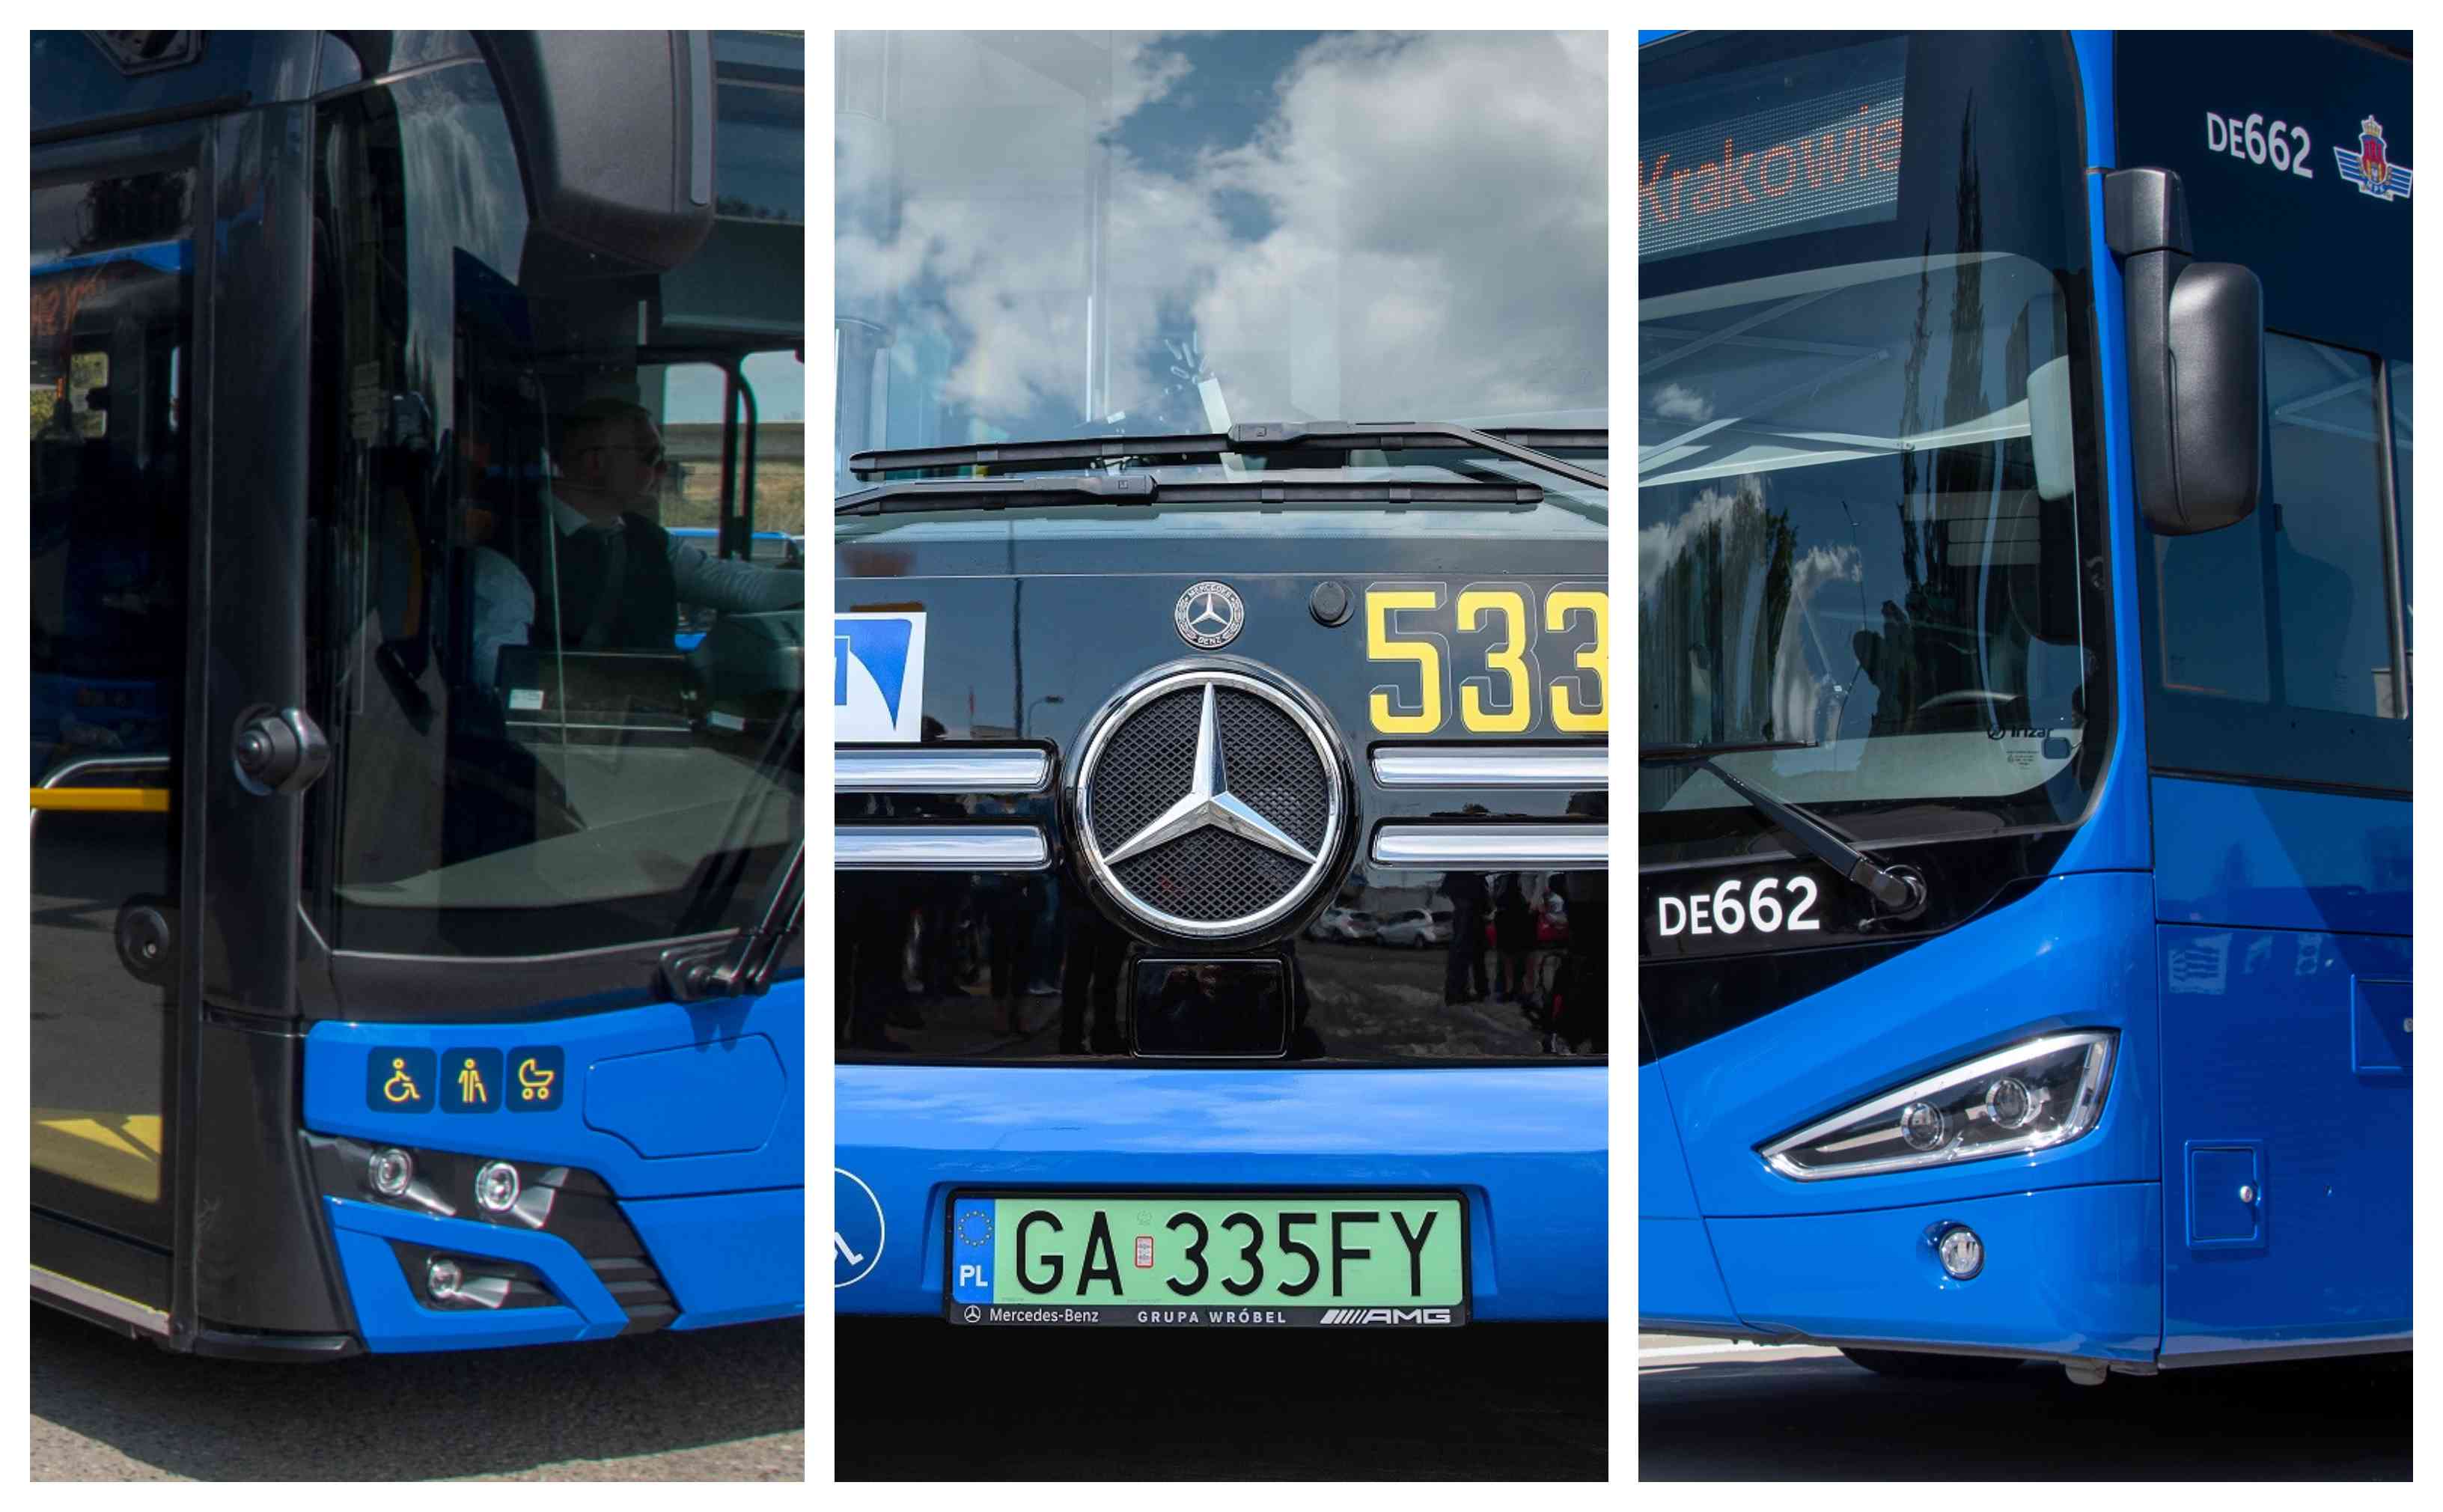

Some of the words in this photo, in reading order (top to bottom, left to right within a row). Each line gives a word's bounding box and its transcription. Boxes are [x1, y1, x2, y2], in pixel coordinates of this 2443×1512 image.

[1638, 103, 1903, 228] Krakowie
[2206, 112, 2314, 179] DE662
[1365, 582, 1608, 734] 533
[1659, 876, 1820, 936] DE662
[960, 1265, 989, 1287] PL
[1016, 1210, 1124, 1296] GA
[1165, 1210, 1439, 1297] 335FY
[989, 1308, 1099, 1323] Mercedes-Benz
[1137, 1311, 1199, 1323] GRUPA
[1209, 1308, 1286, 1323] WRÓBEL
[1361, 1308, 1451, 1324] AMG
